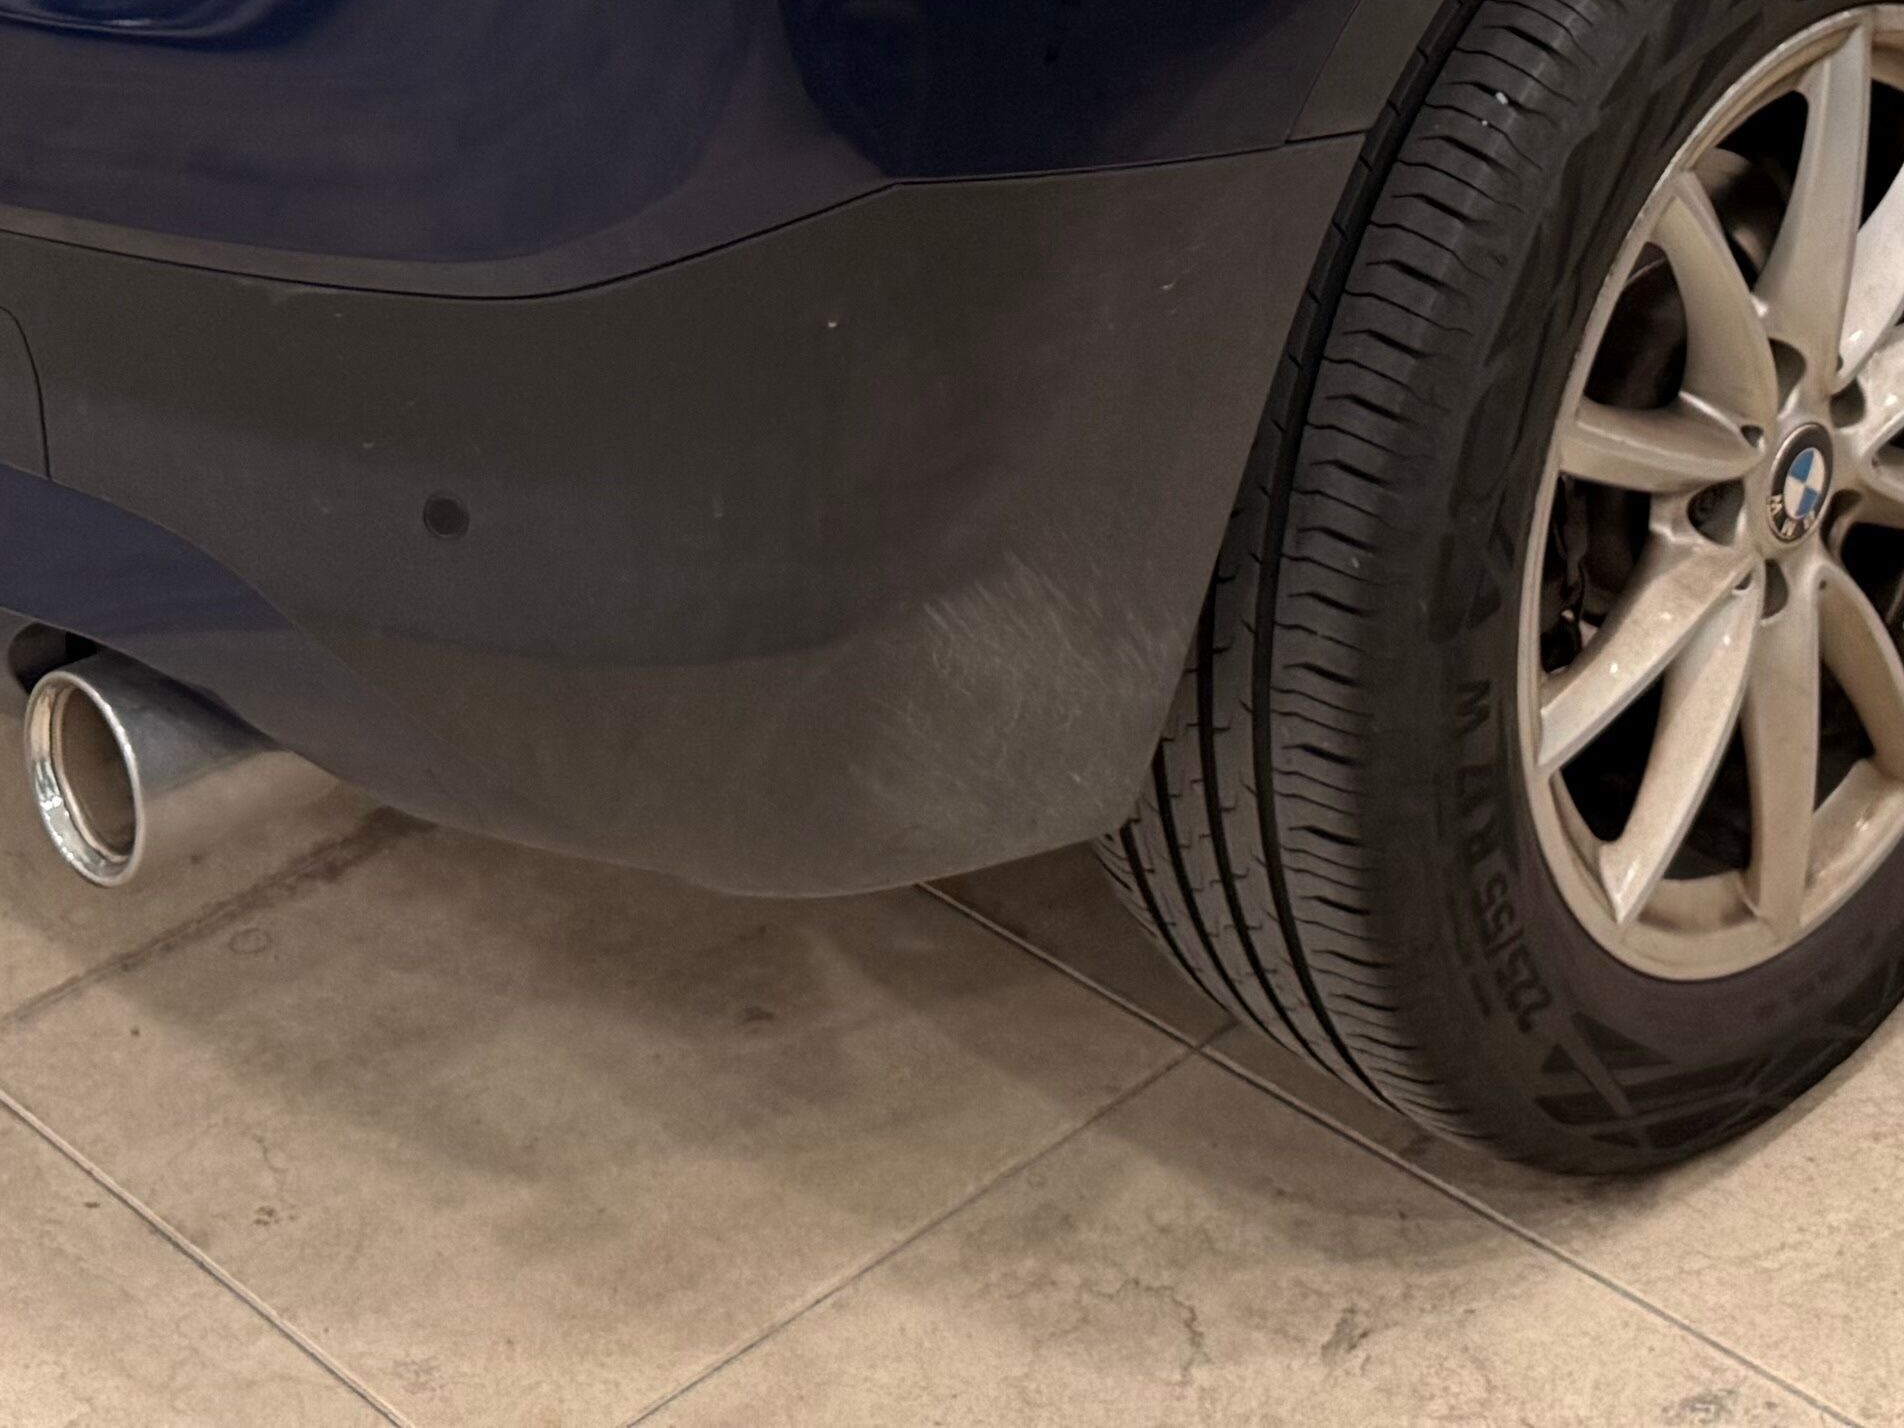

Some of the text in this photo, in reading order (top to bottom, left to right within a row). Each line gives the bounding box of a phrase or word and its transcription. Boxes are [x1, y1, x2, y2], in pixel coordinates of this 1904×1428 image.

[1767, 493, 1817, 538] BMW
[1452, 679, 1494, 740] W
[1478, 869, 1554, 1035] 225/55
